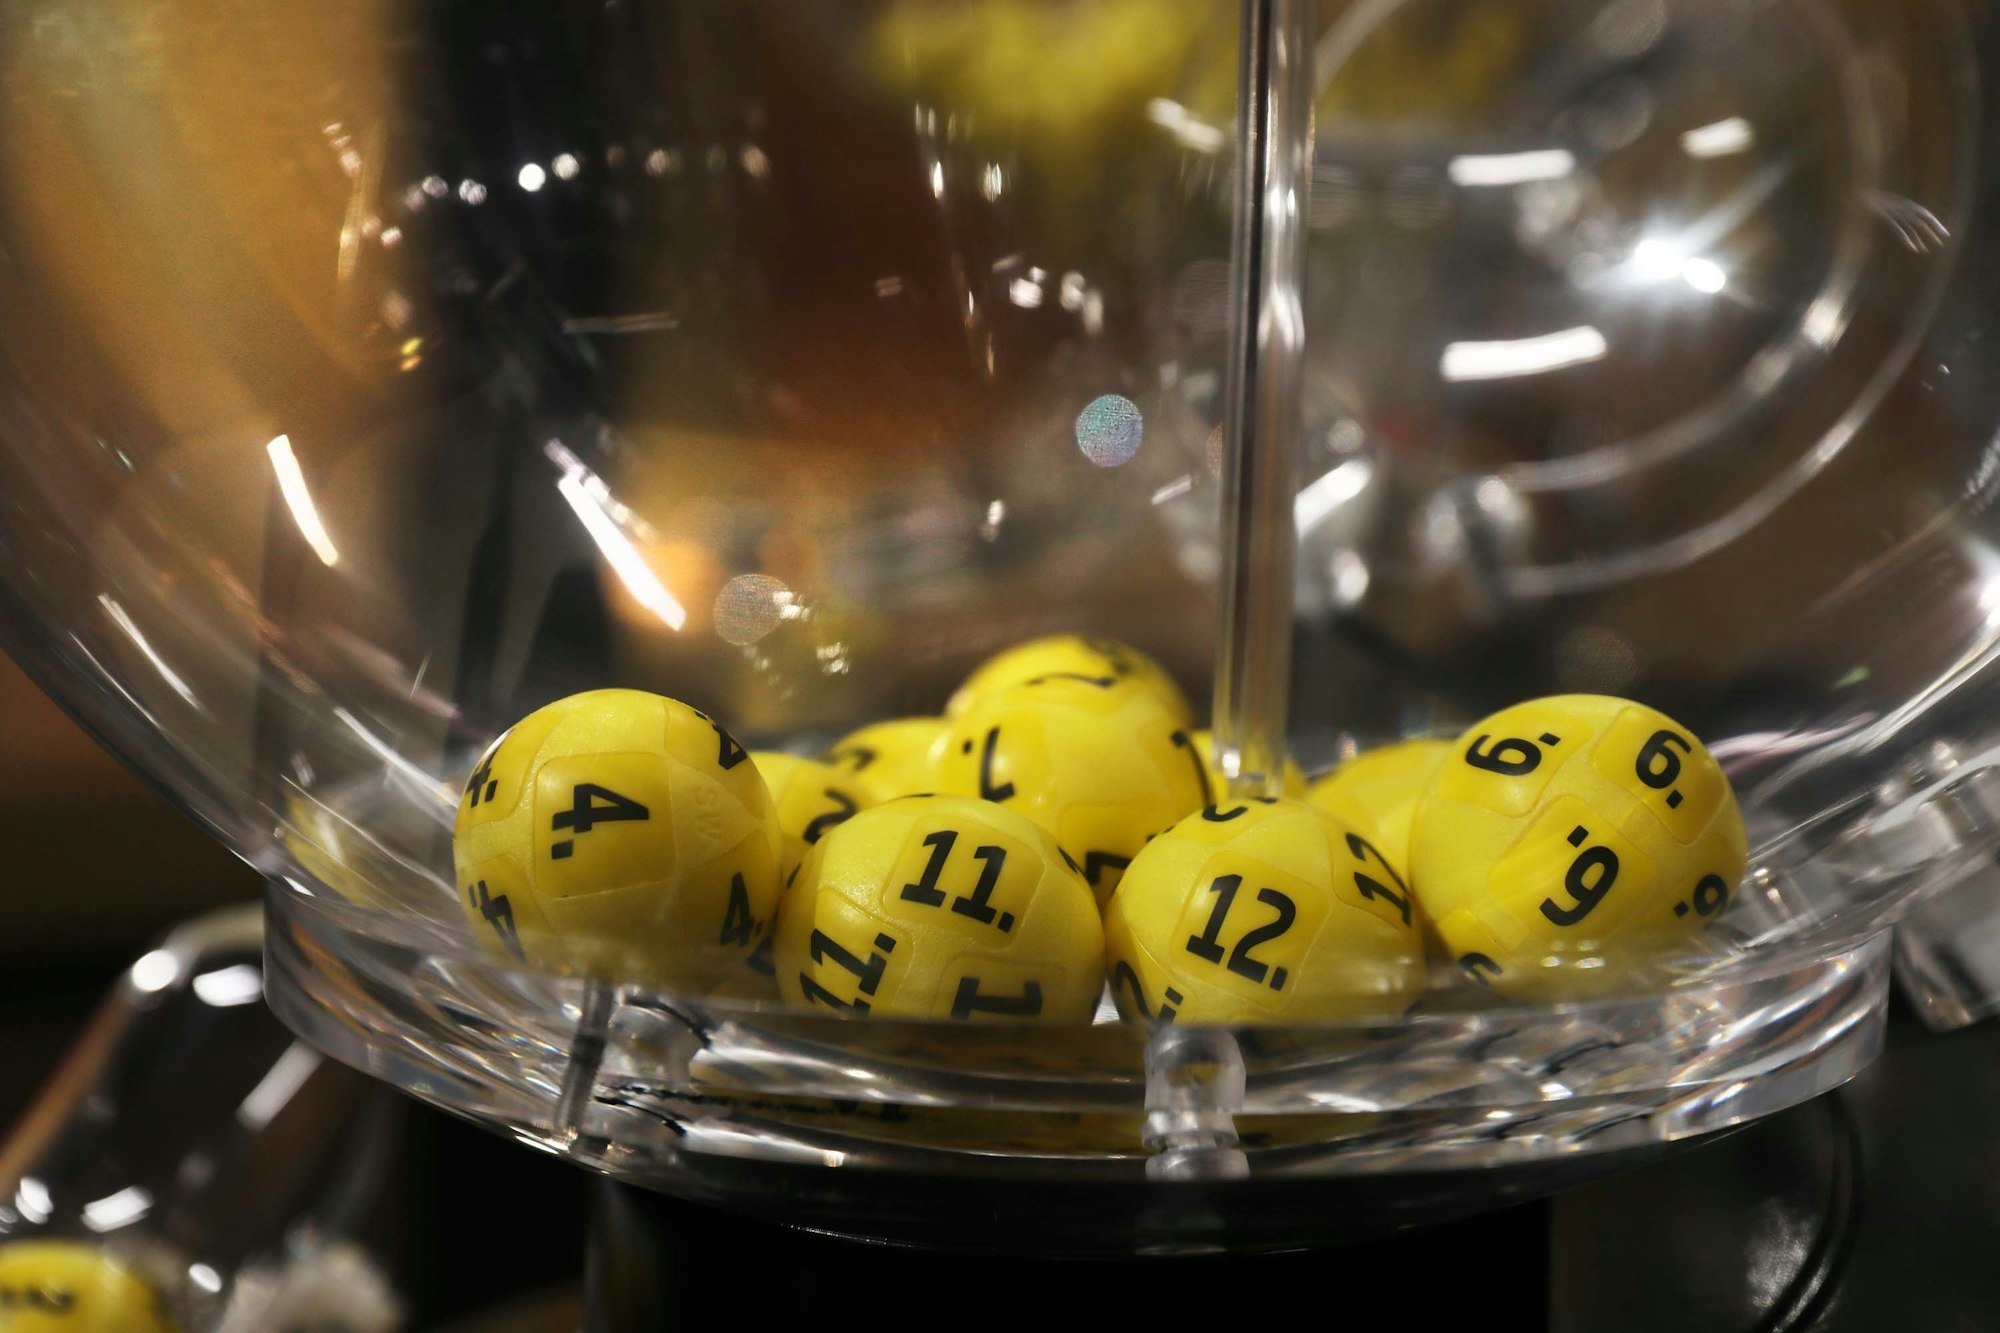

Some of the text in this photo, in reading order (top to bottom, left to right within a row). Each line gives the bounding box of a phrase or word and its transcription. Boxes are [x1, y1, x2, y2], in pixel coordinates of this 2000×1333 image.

[551, 783, 650, 860] 4.
[900, 829, 1015, 933] 11.
[1186, 873, 1289, 992] 12.
